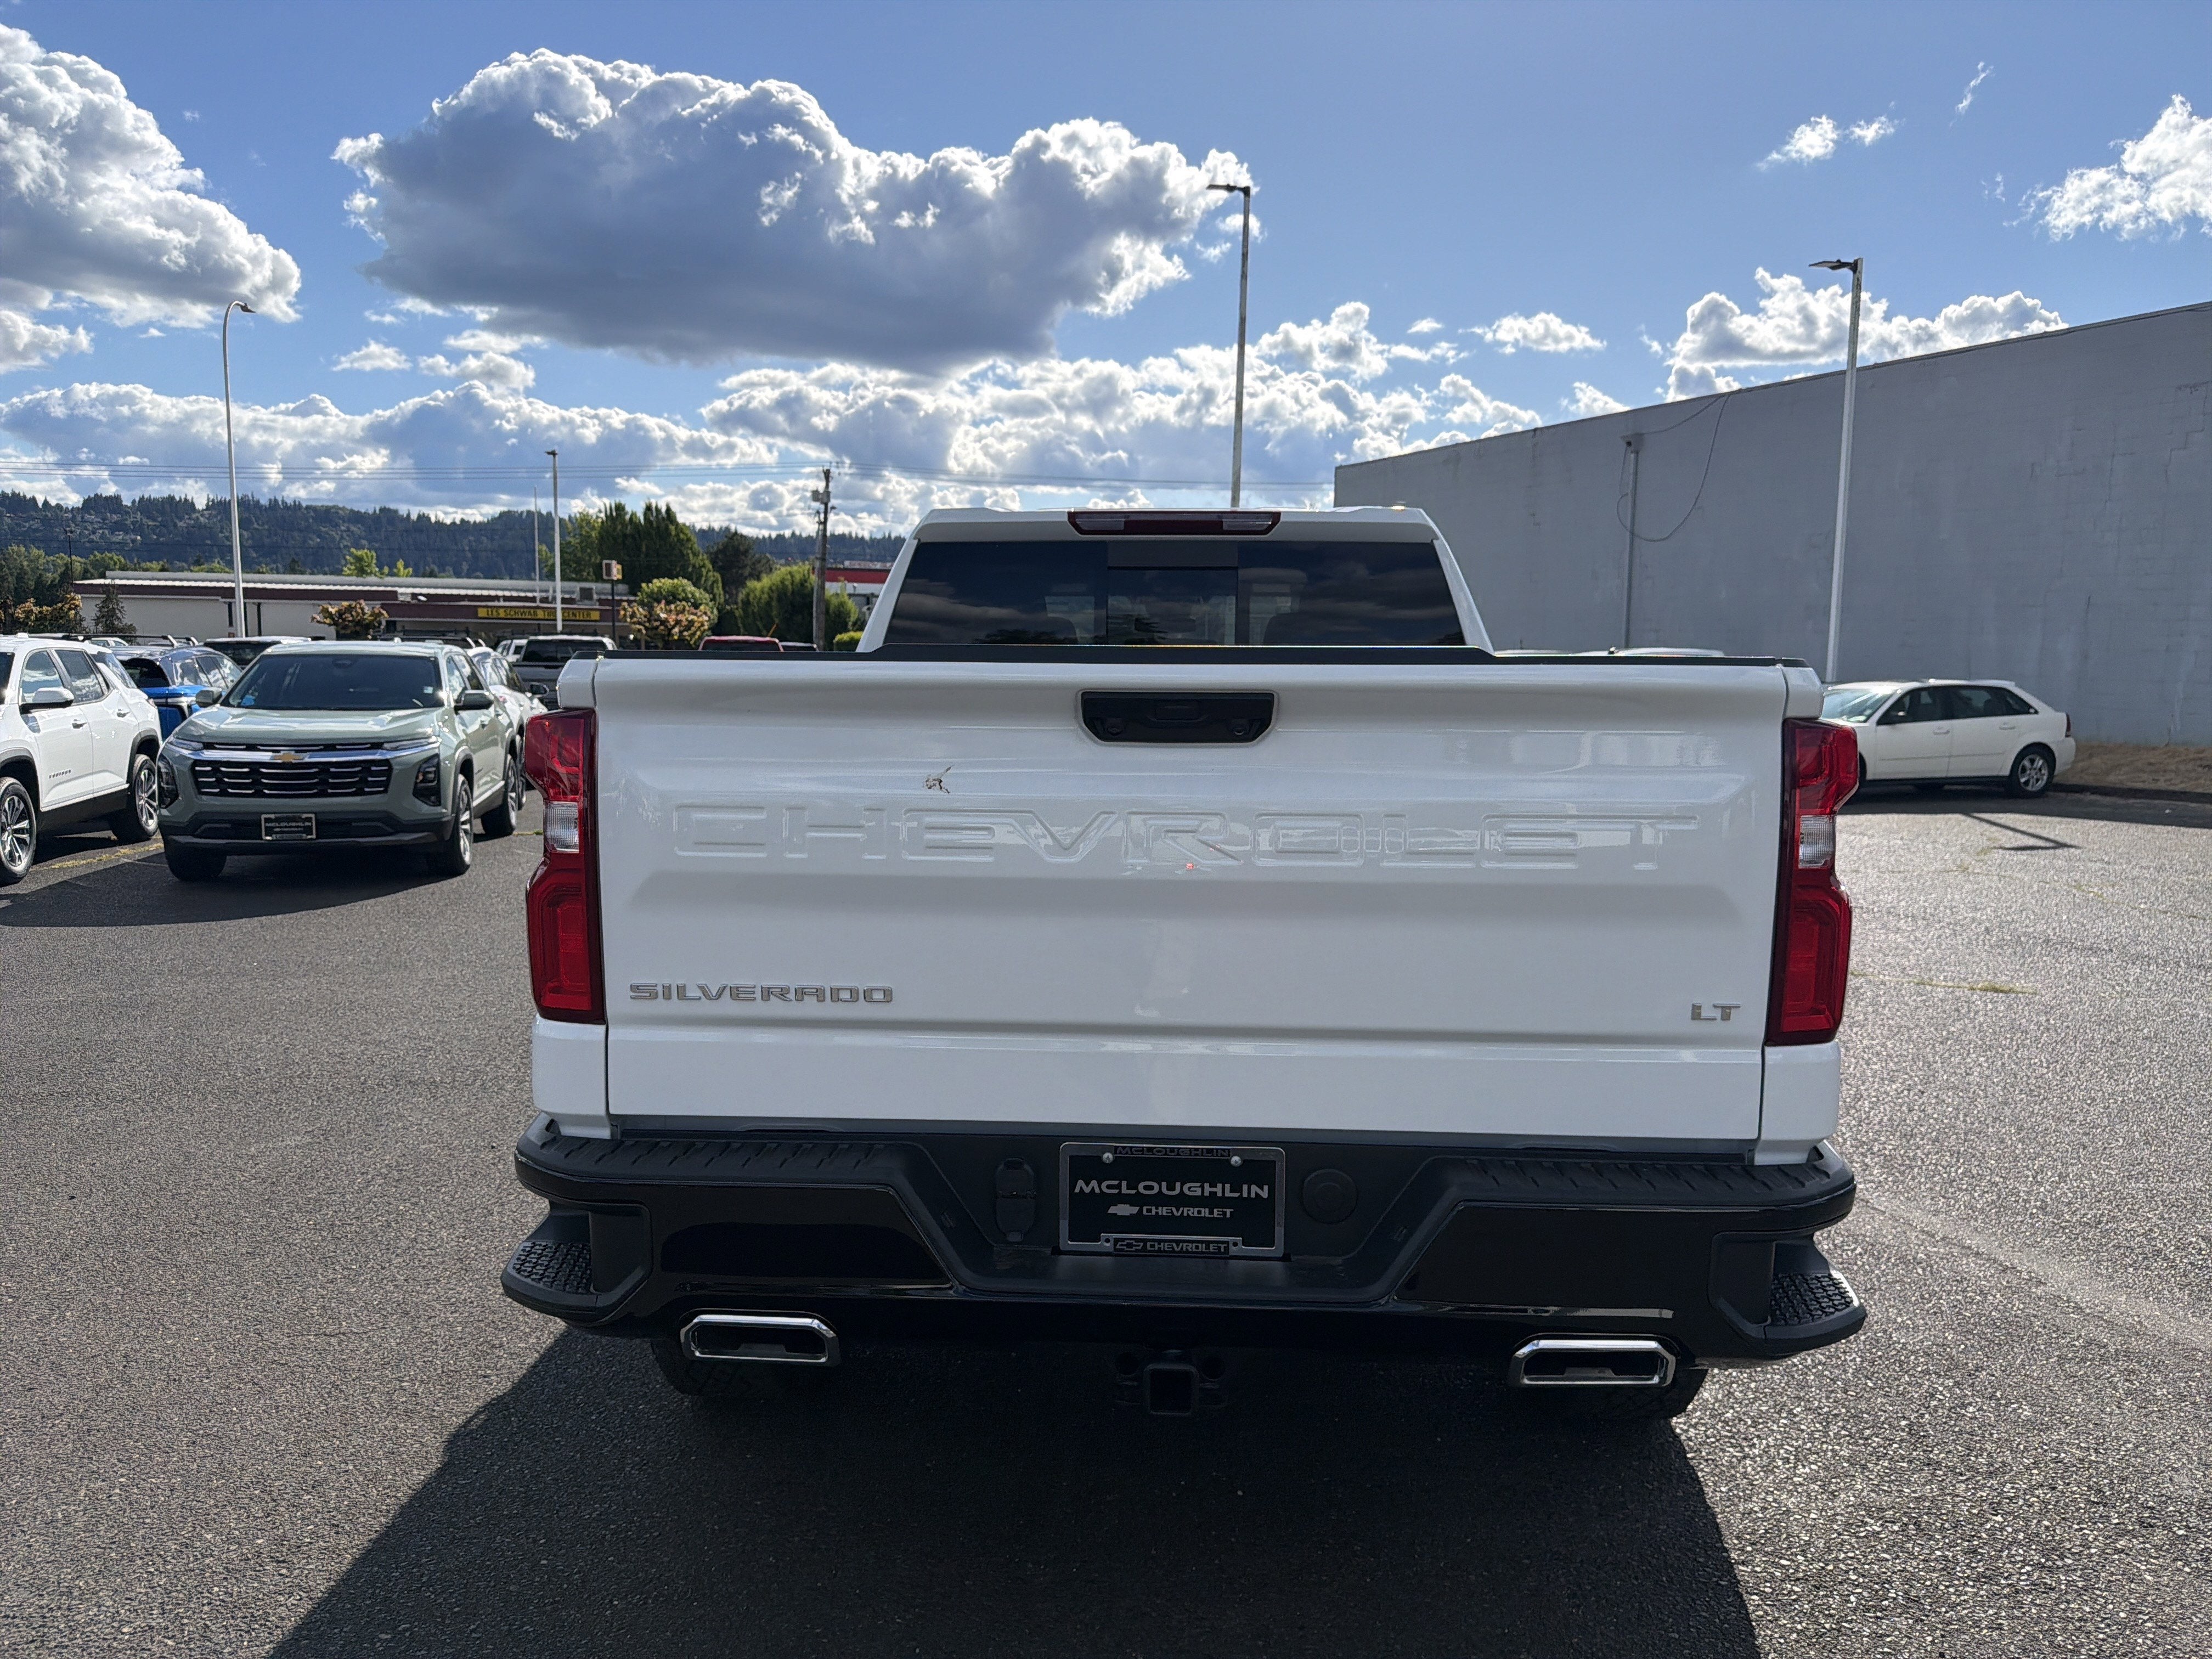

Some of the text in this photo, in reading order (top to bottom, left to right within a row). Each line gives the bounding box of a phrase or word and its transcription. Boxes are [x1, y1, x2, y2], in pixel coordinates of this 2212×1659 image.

[561, 611, 592, 619] CENTER
[674, 804, 1700, 871] CHEVROLET
[629, 982, 894, 1003] SILVERADO
[1690, 1002, 1741, 1021] LT
[1115, 1146, 1229, 1158] MCLOUGHLIN
[1074, 1179, 1269, 1199] MCLOUGHLIN
[1142, 1205, 1234, 1218] CHEVROLET
[1147, 1242, 1227, 1253] CHEVROLET
